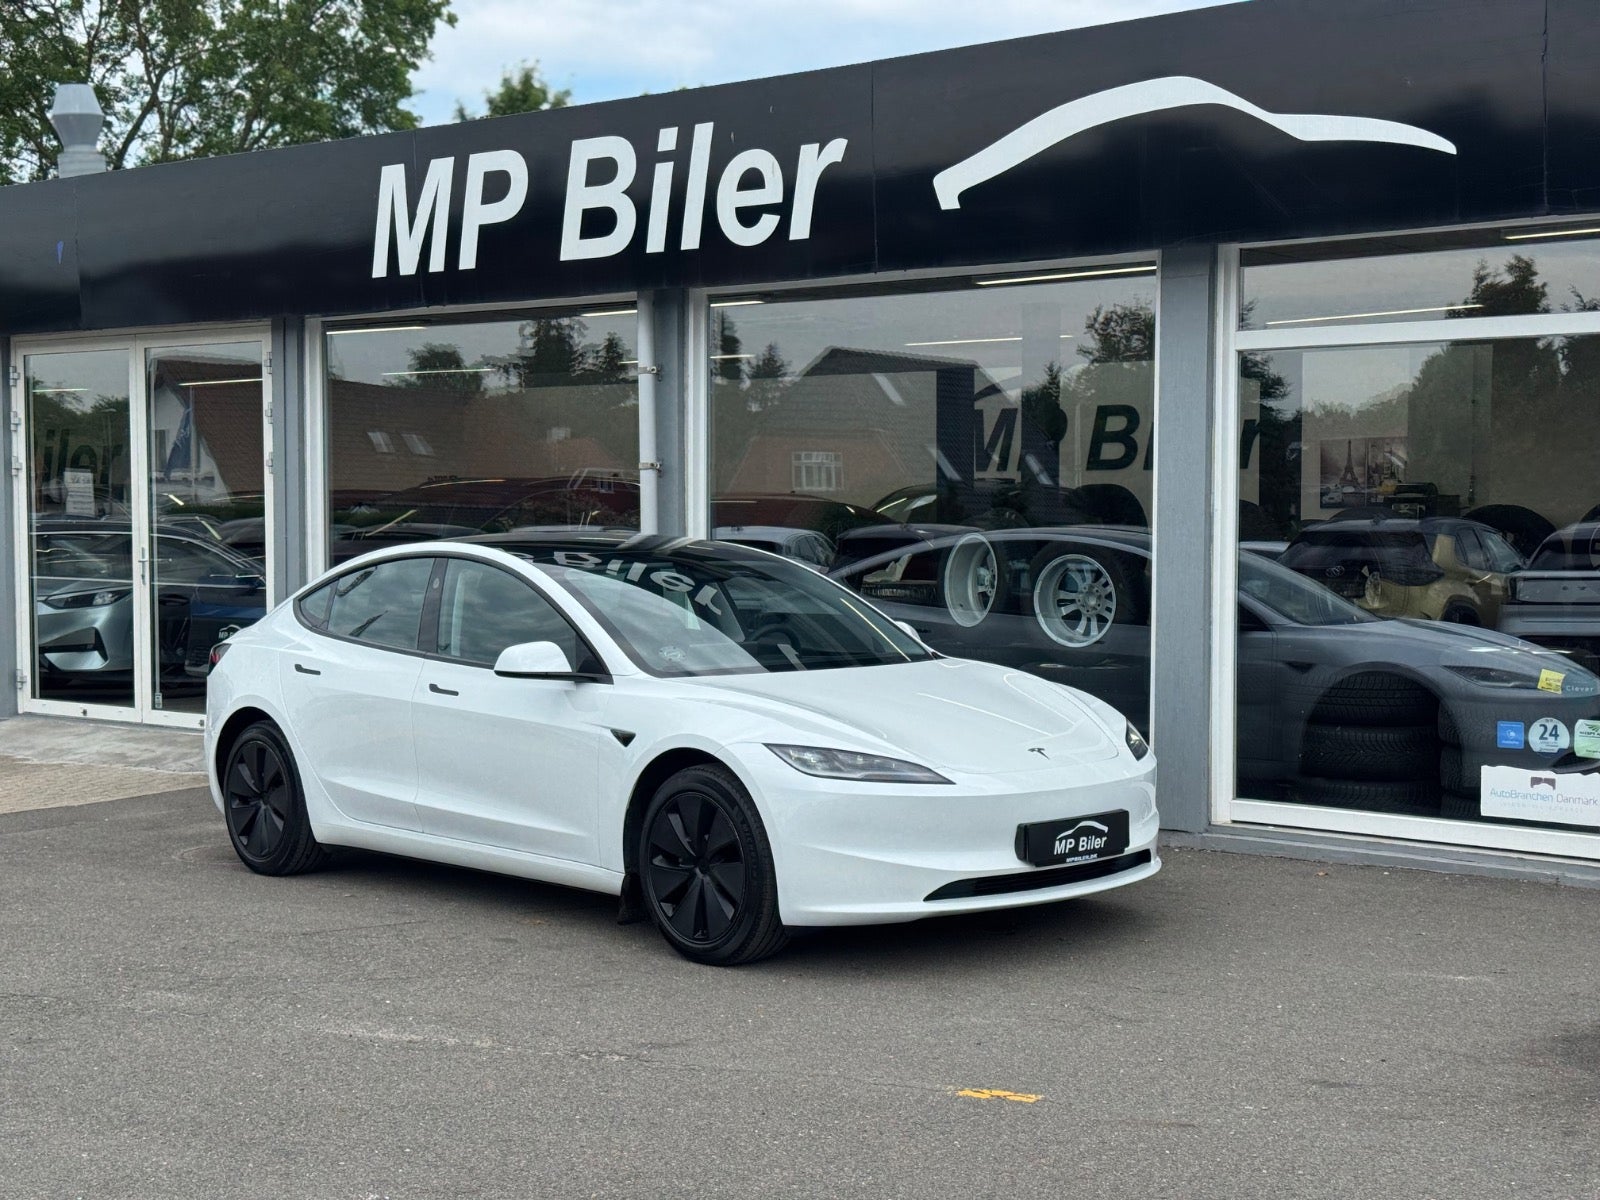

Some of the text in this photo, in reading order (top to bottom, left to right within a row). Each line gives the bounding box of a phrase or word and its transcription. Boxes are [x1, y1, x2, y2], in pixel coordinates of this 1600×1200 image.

[371, 122, 847, 279] MP Biler
[1539, 723, 1559, 741] 24
[1490, 788, 1599, 806] AutoBranchen Danmark
[1054, 836, 1107, 855] MP Biler
